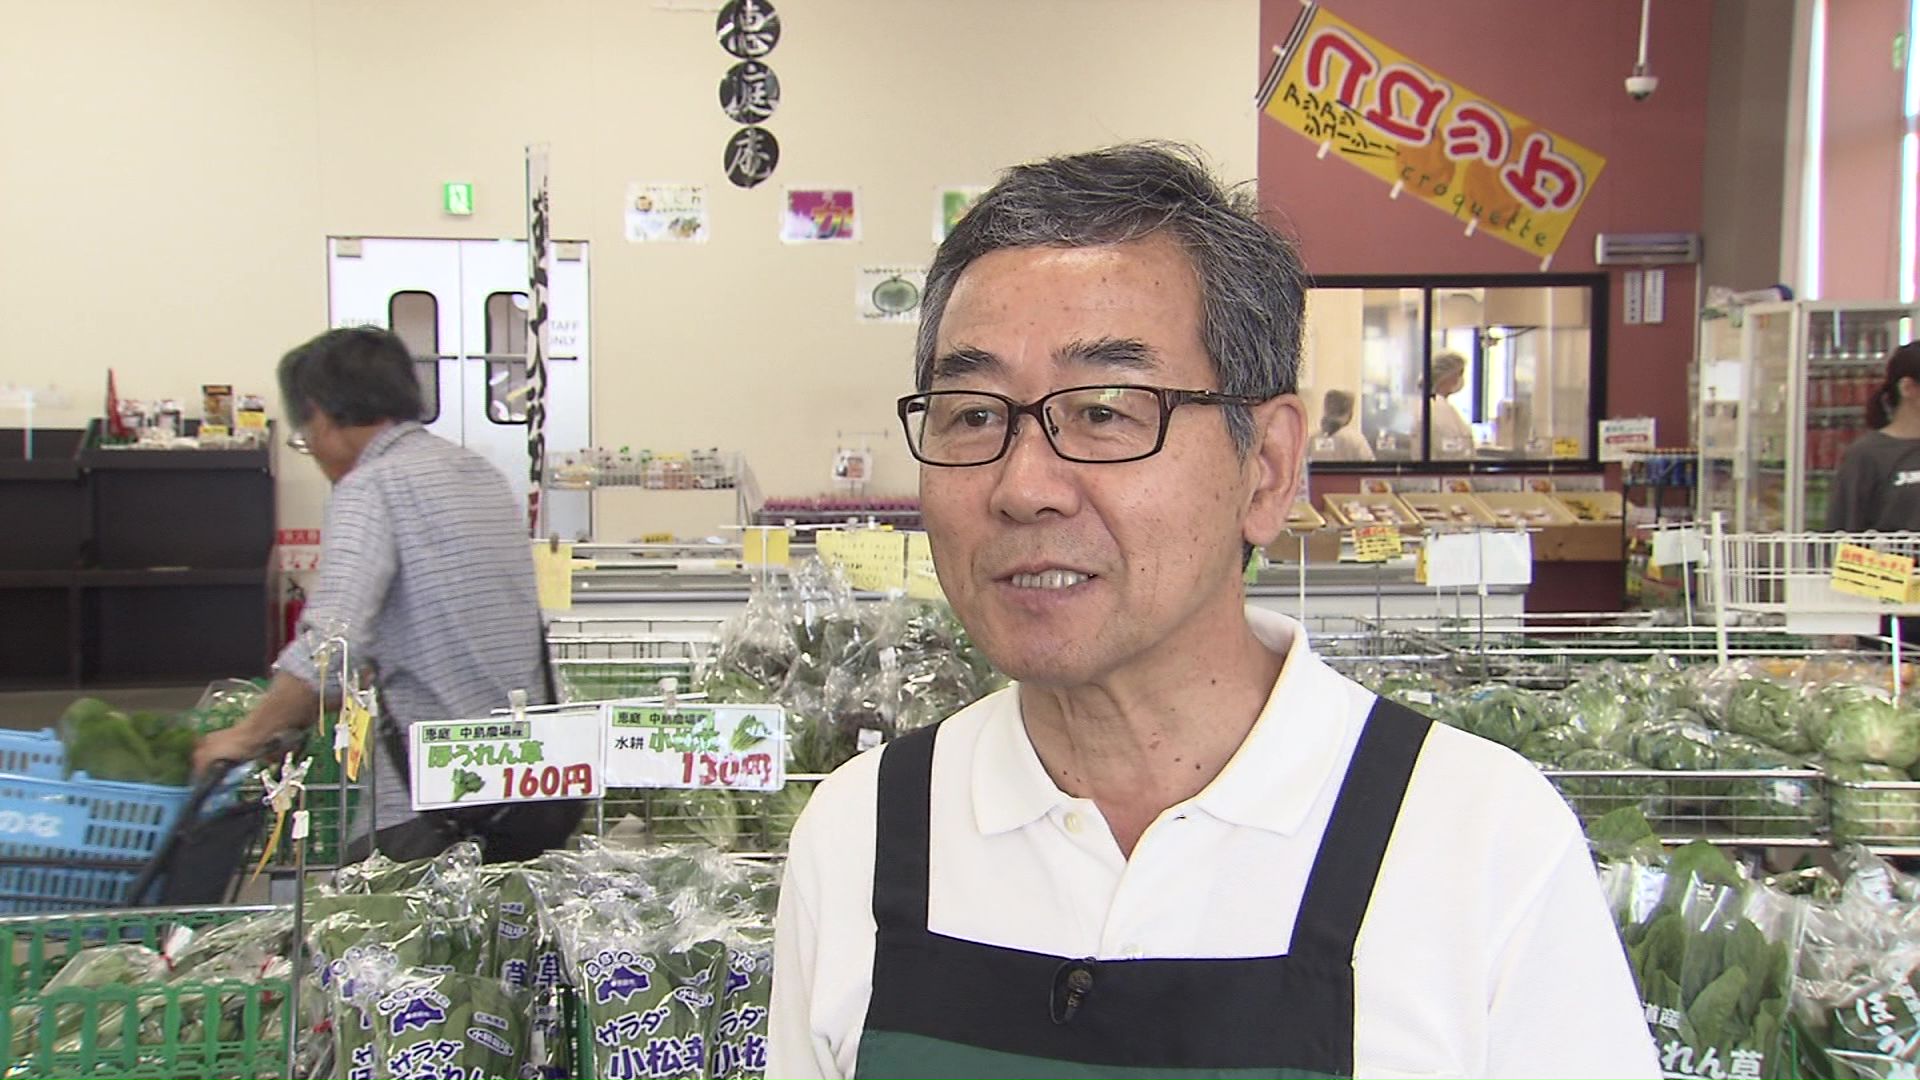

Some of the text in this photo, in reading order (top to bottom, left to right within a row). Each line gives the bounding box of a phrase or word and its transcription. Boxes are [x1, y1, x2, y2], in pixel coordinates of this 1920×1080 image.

[1306, 29, 1585, 210] コロッケ
[1401, 164, 1547, 248] croquette
[614, 735, 644, 751] 水耕
[502, 762, 593, 798] 160円
[681, 751, 773, 786] 130円
[598, 1009, 669, 1044] サラダ
[390, 1041, 463, 1074] サラダ
